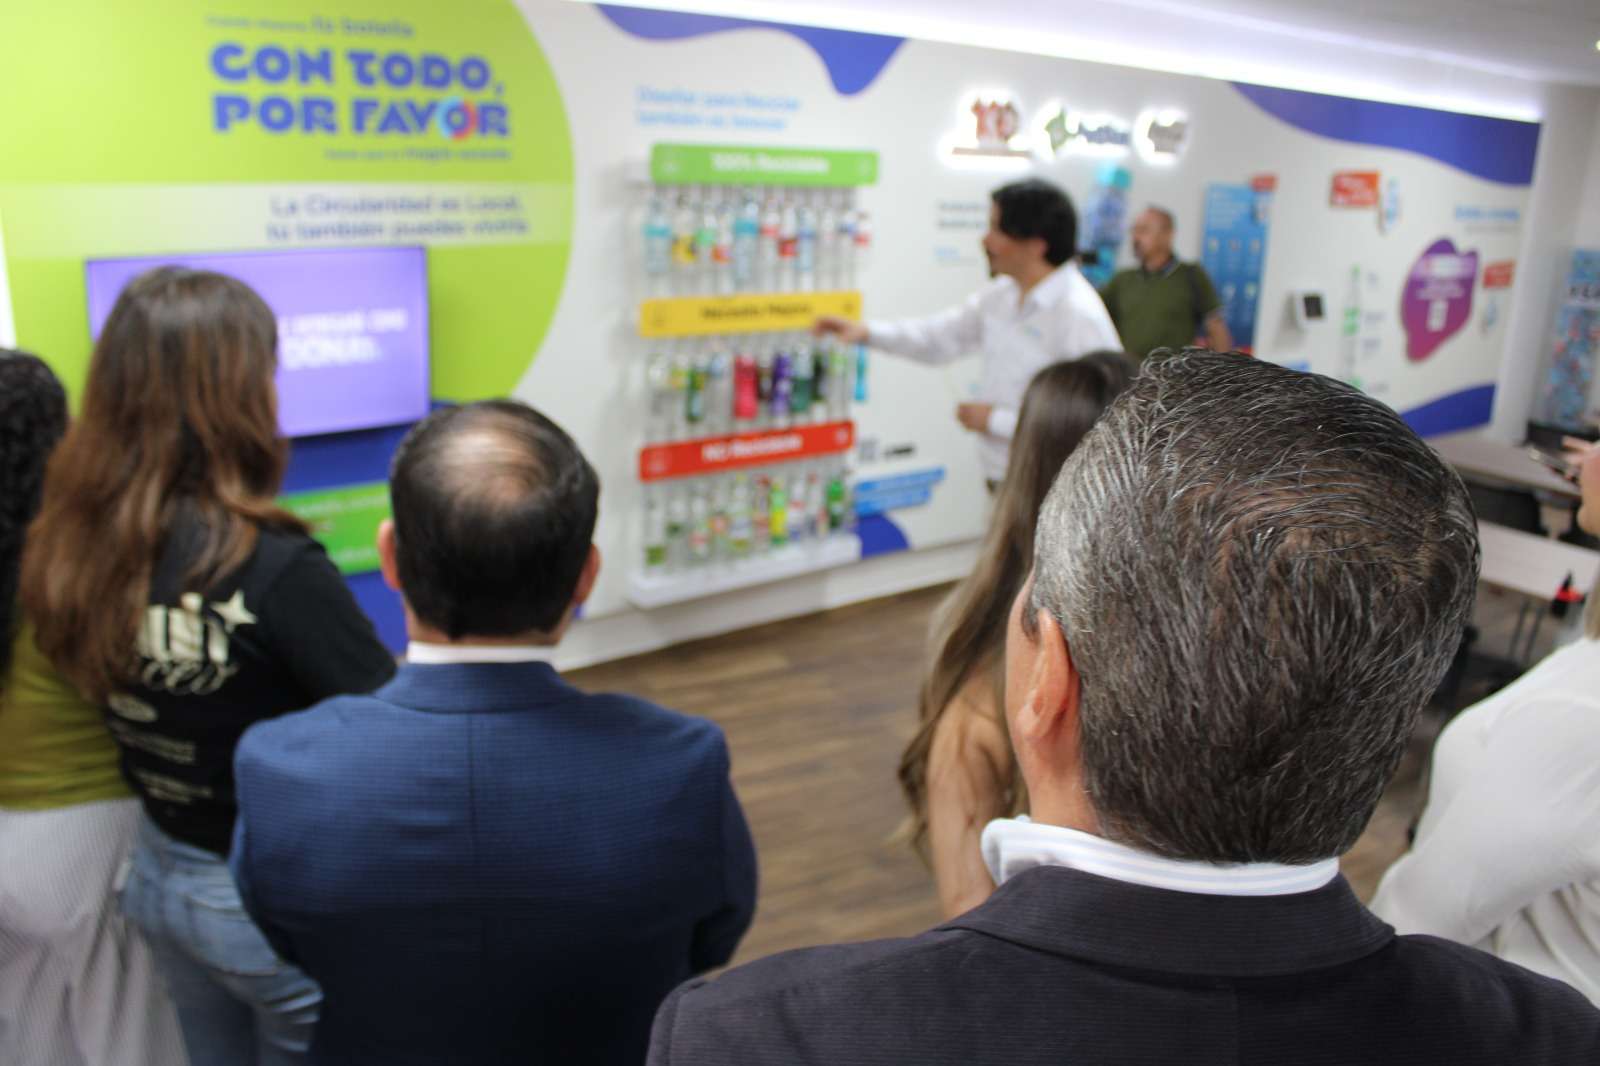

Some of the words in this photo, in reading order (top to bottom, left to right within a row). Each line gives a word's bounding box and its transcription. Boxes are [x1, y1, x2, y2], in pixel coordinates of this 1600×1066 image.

[209, 42, 335, 84] CON
[345, 50, 506, 97] TODO,
[211, 94, 338, 134] POR
[351, 97, 511, 139] FAVOR
